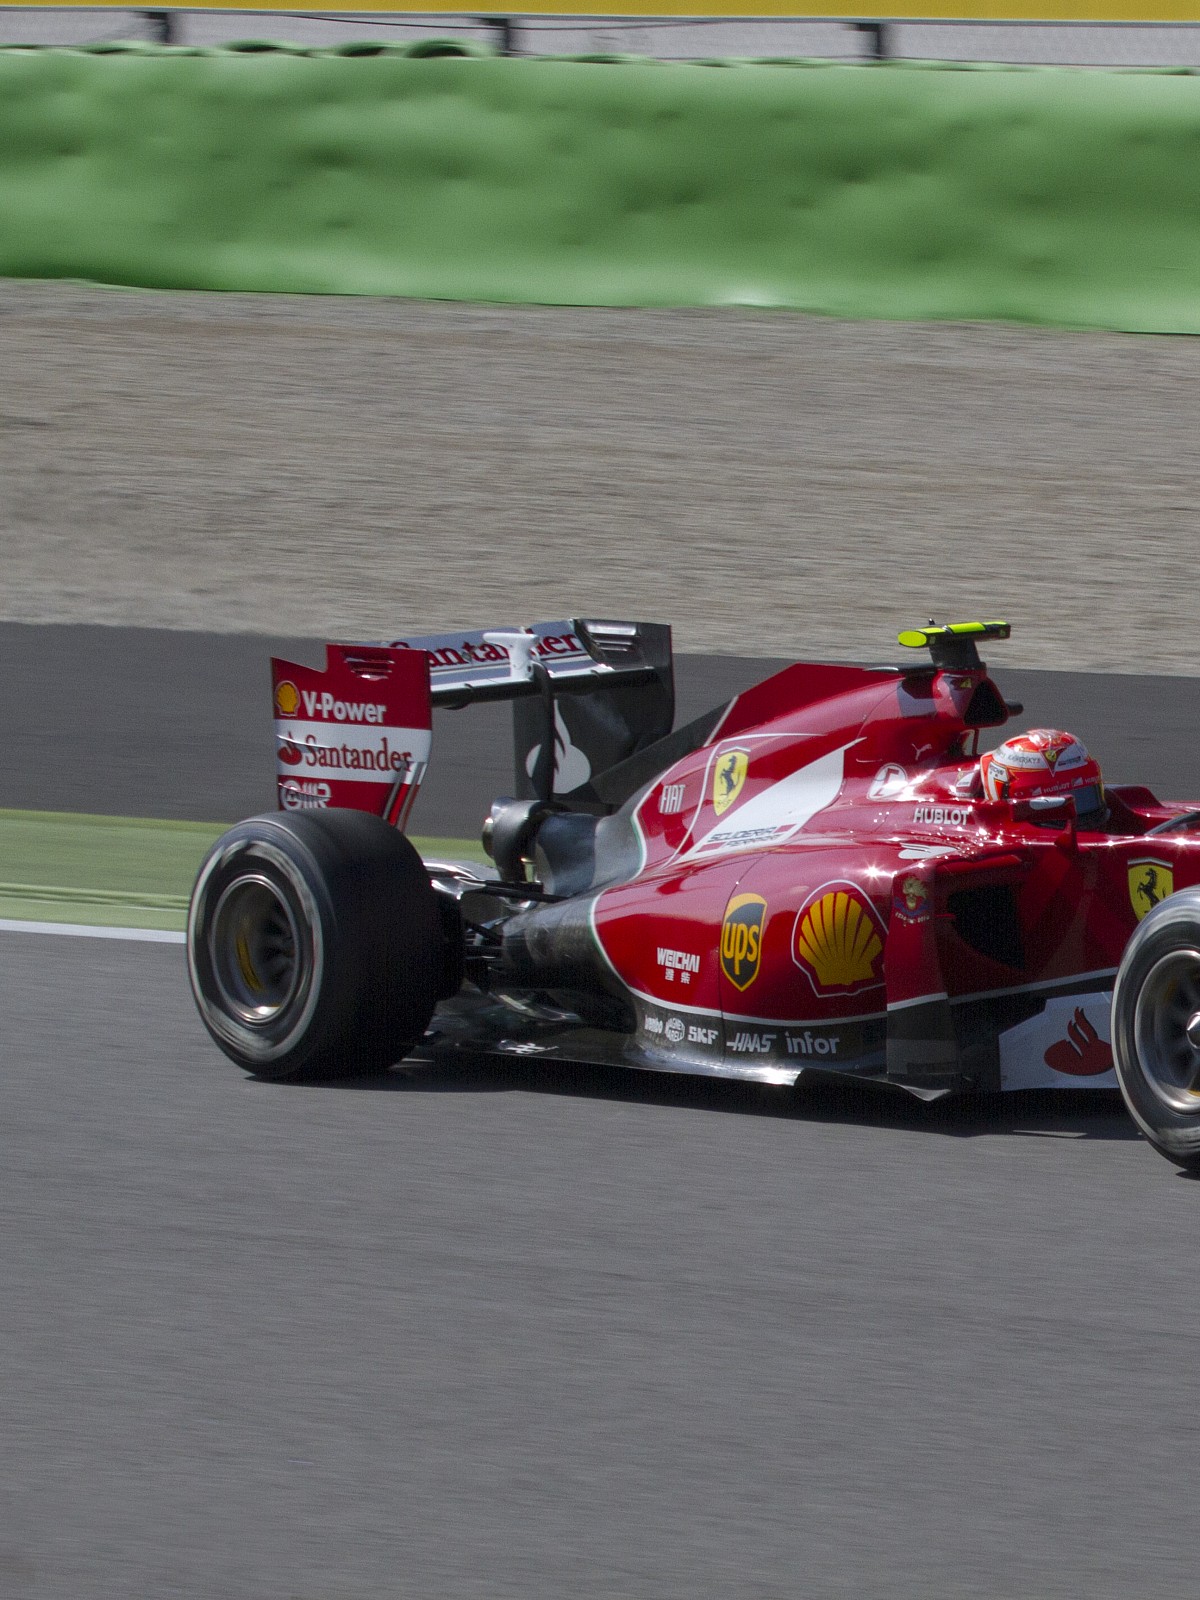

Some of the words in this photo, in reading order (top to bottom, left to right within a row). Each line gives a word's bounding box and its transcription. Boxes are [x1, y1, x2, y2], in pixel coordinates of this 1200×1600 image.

[390, 628, 583, 668] antaer
[302, 690, 387, 723] V-Power
[305, 734, 412, 772] Santander
[660, 785, 686, 813] FIAT
[912, 808, 969, 826] HUBLOT
[657, 946, 700, 973] WEICHAI
[723, 922, 760, 975] ups
[688, 1026, 719, 1045] SKF
[726, 1033, 777, 1053] HAAS
[786, 1031, 840, 1054] infor
